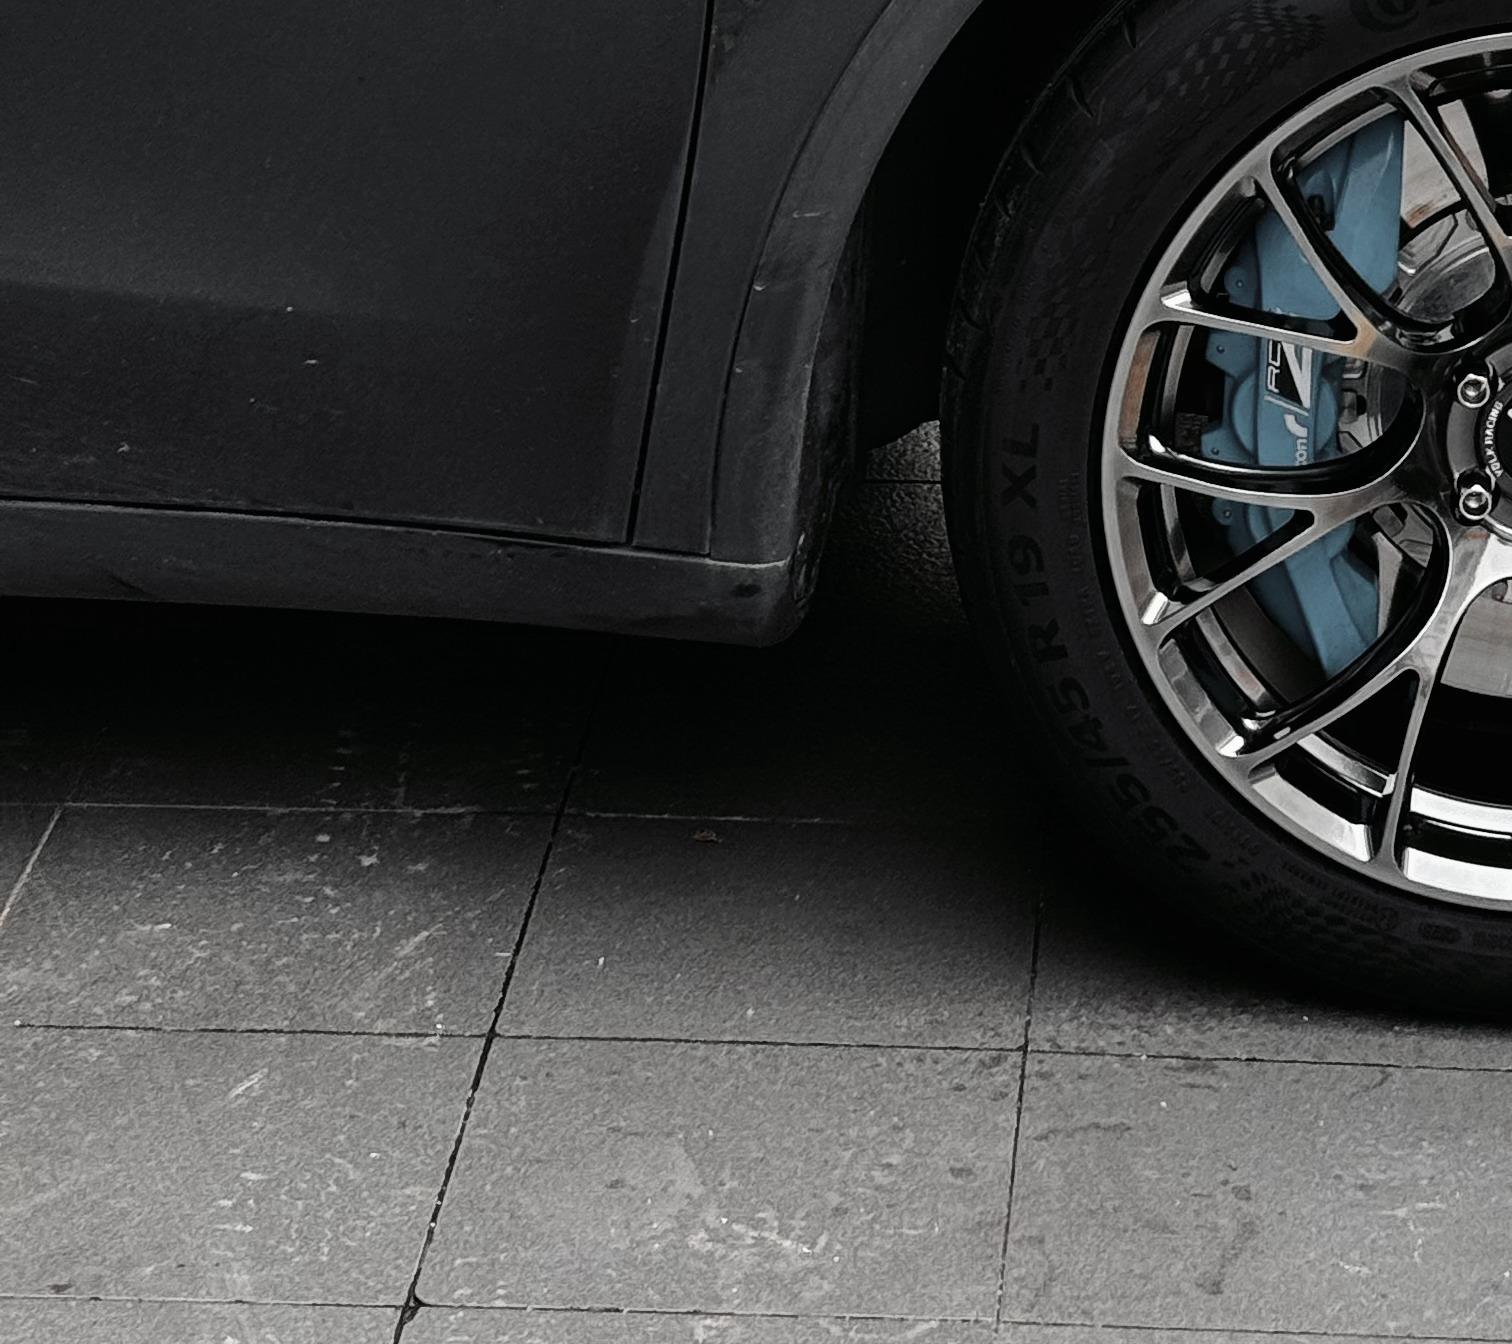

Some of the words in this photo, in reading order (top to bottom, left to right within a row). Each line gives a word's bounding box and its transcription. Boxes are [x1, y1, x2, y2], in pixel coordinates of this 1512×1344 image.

[1484, 401, 1503, 445] RACING
[1001, 422, 1040, 509] XL
[1028, 617, 1068, 663] R
